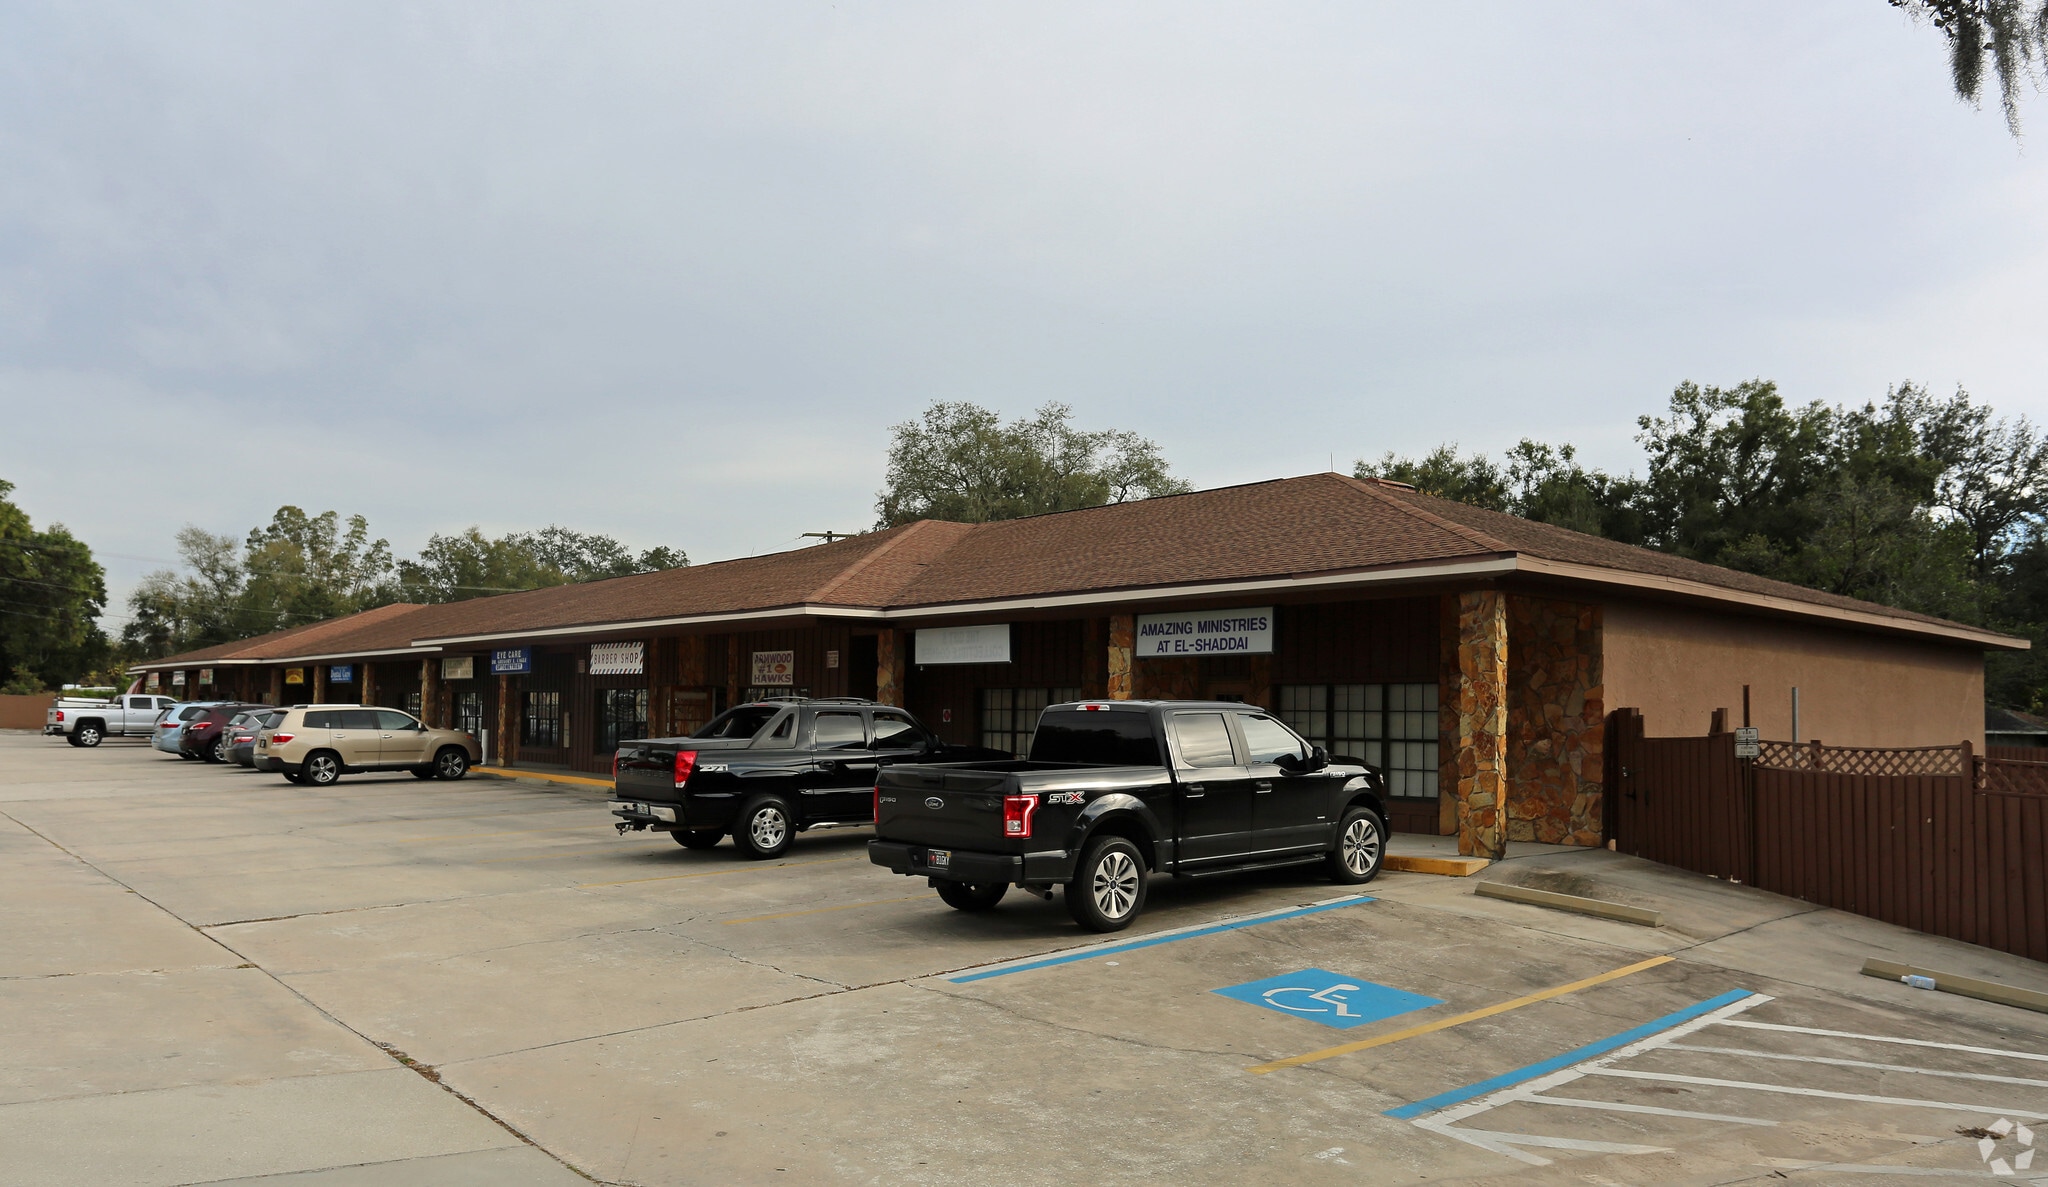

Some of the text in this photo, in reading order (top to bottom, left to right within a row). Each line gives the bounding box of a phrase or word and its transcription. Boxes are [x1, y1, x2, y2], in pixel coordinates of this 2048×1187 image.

[1140, 616, 1267, 637] AMAZING MINISTRIES
[1156, 636, 1248, 653] AT EL-SHADDAI
[496, 650, 521, 660] EYE CARE
[594, 652, 639, 665] BARBER SHOP
[754, 653, 792, 664] ARMWOOD
[758, 664, 772, 674] #1
[754, 673, 792, 683] HAWKS
[1047, 790, 1086, 805] STX
